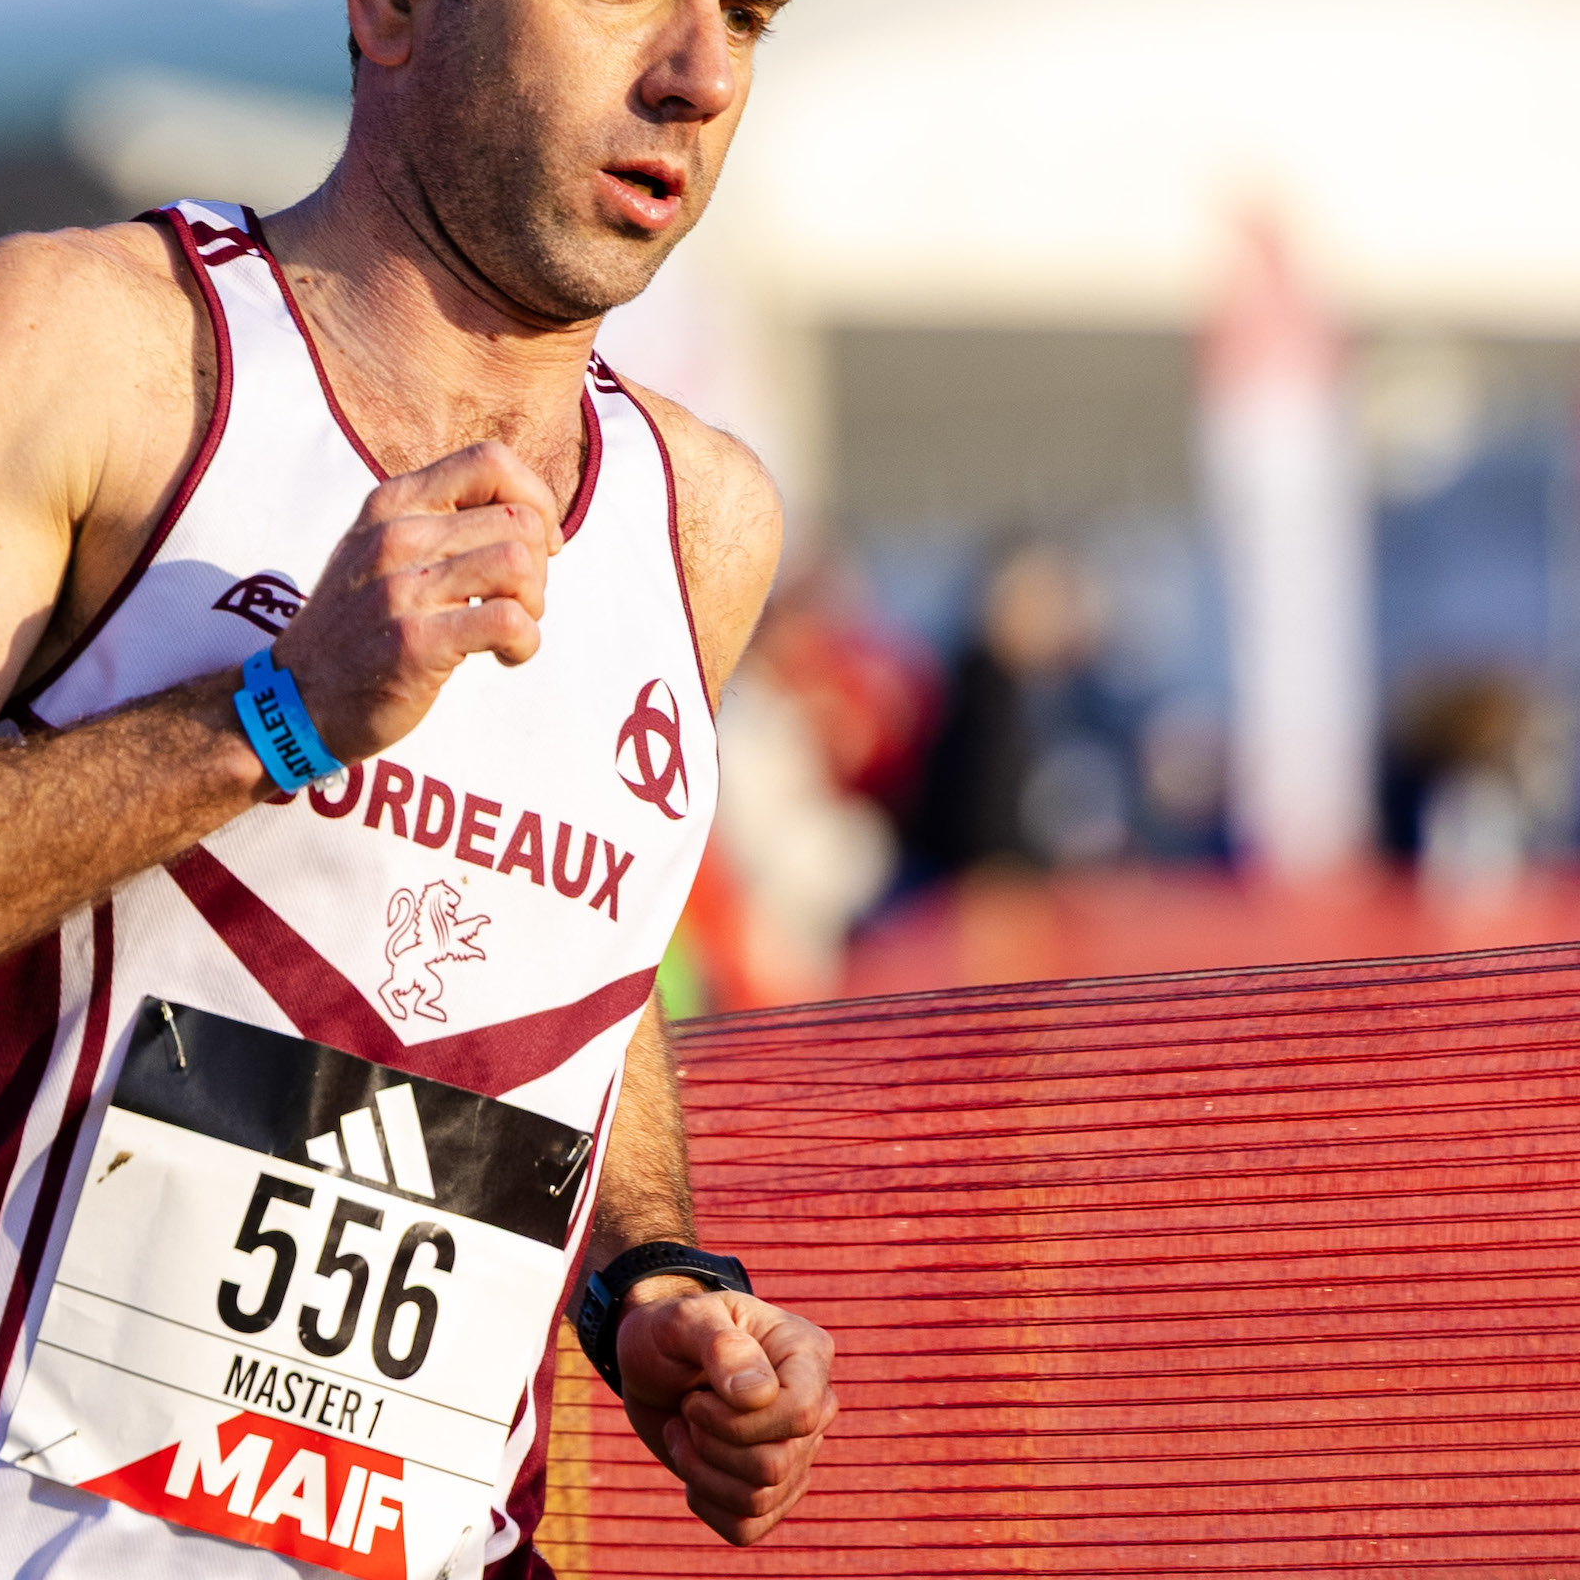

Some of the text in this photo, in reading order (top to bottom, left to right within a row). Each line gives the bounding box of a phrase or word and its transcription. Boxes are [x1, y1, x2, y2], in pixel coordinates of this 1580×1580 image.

[253, 686, 318, 780] ATHLETE
[263, 758, 635, 922] ORDEAUX
[216, 1171, 457, 1382] 556
[223, 1354, 386, 1440] MASTER 1
[164, 1421, 406, 1556] MAIF
